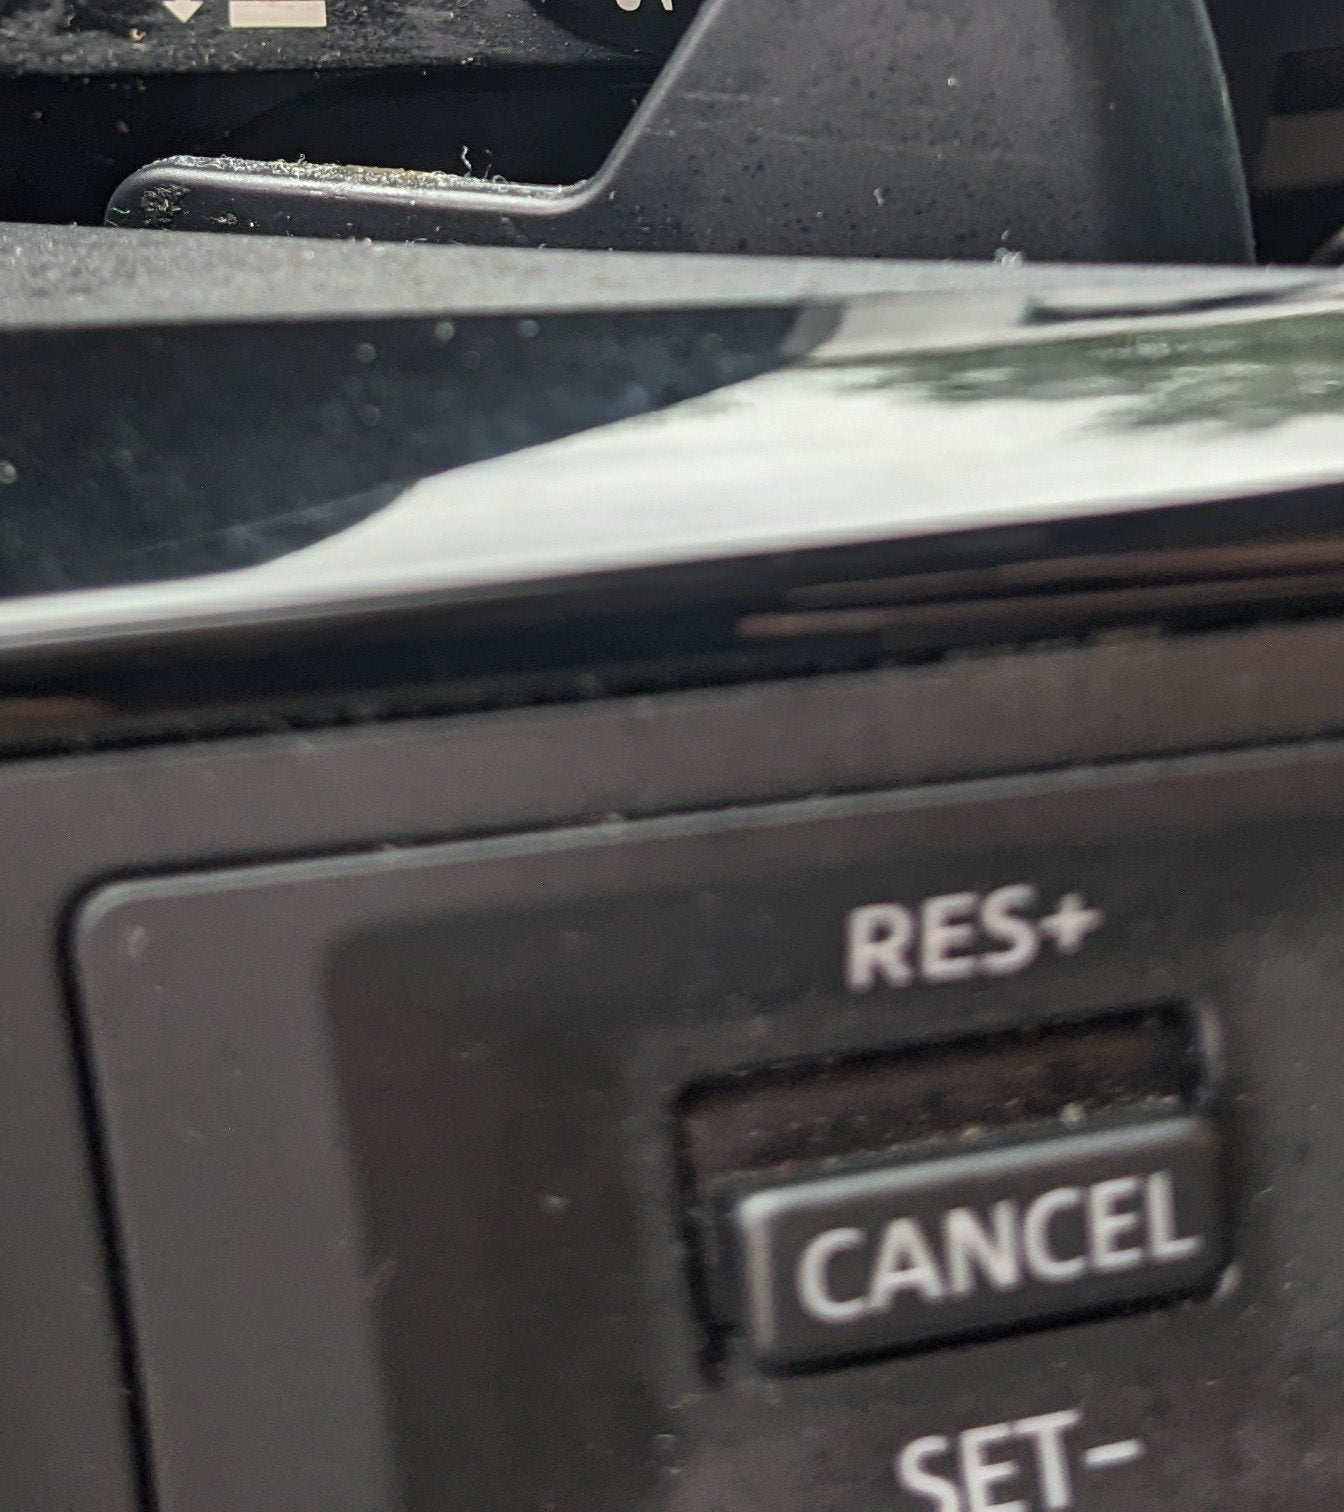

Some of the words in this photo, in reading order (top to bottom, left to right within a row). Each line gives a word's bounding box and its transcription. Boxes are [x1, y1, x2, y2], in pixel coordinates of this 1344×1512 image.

[844, 883, 1100, 990] RES+
[799, 1172, 1201, 1324] CANCEL
[895, 1406, 1145, 1512] SET-
